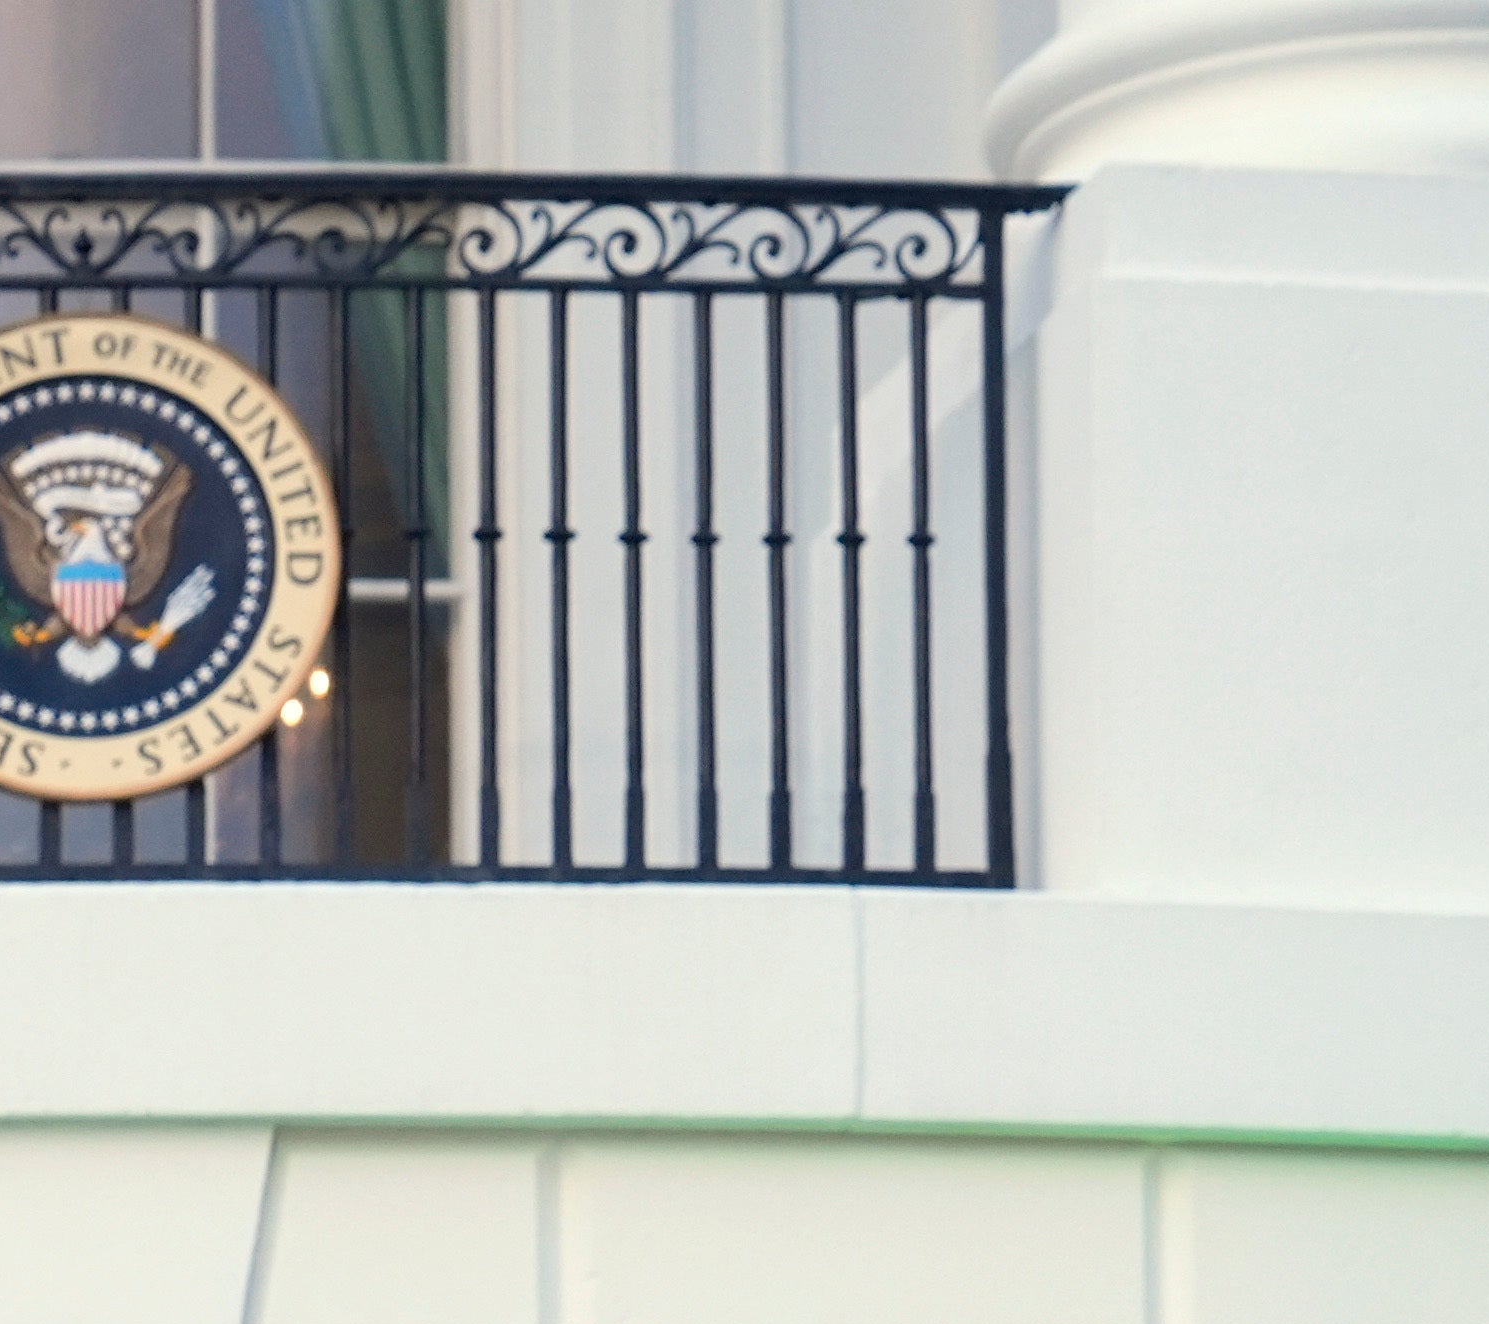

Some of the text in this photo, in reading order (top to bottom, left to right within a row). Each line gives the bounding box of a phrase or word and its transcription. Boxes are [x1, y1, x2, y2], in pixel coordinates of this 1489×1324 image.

[94, 333, 137, 360] OF
[152, 343, 214, 390] THE
[225, 384, 322, 586] UNITED
[137, 624, 302, 776] STATES
